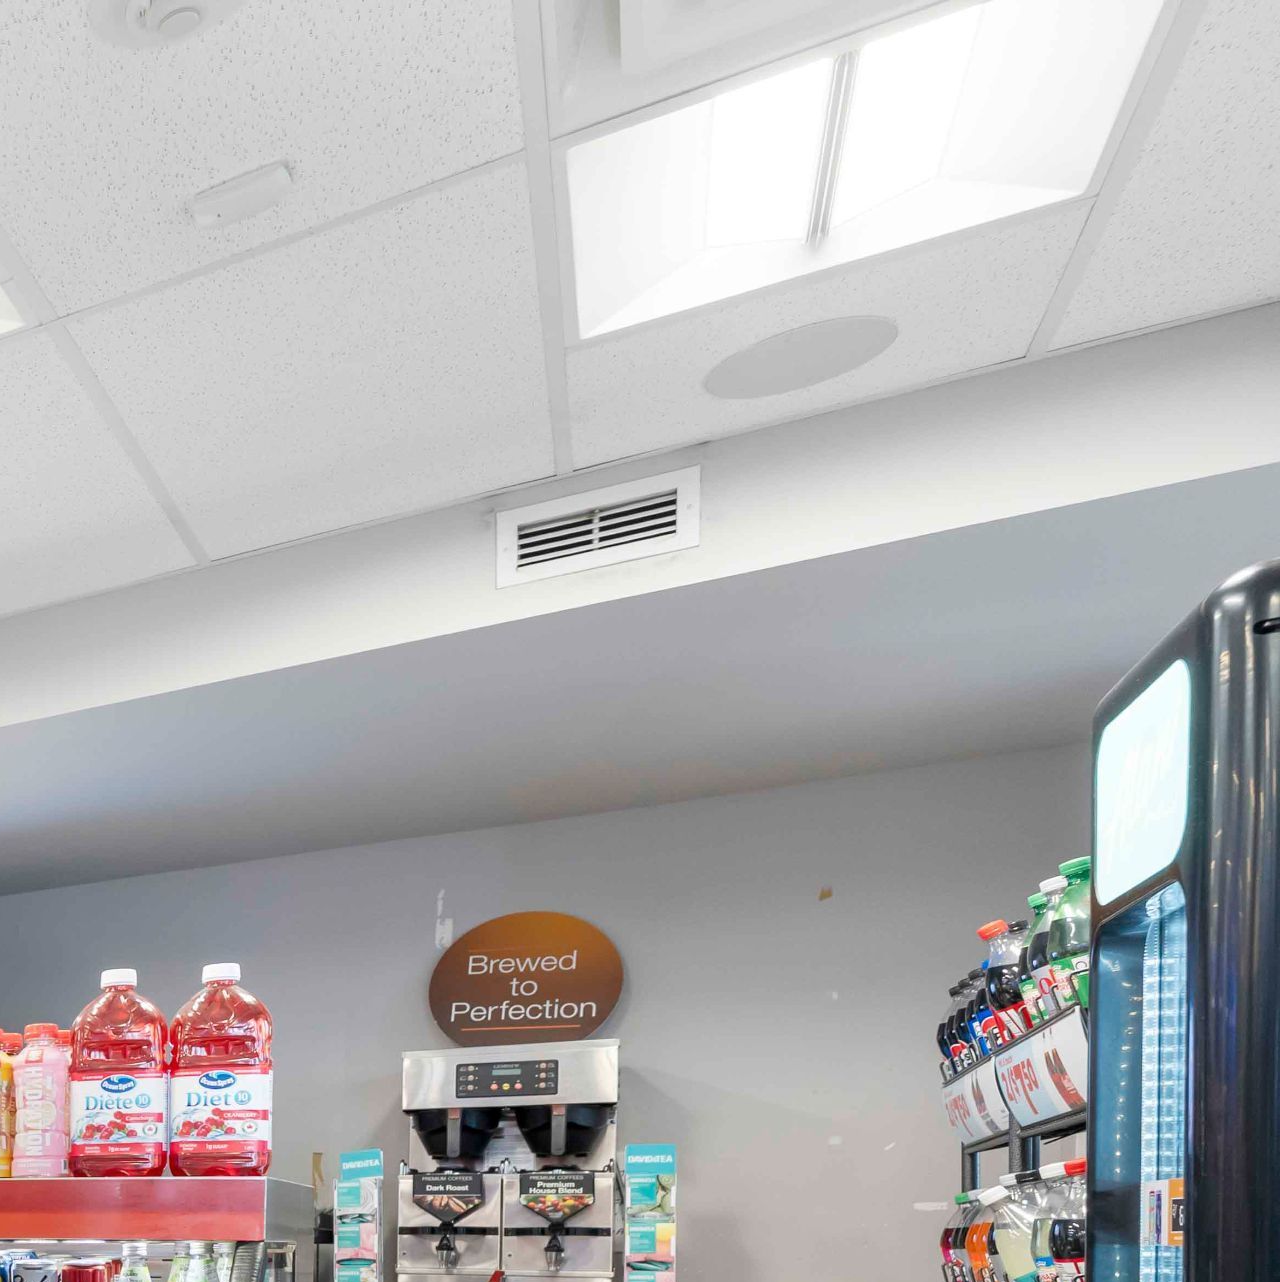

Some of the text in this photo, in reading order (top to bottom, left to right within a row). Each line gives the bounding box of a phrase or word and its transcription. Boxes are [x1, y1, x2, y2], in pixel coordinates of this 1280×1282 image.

[467, 950, 579, 976] Brewed
[509, 976, 539, 998] to
[449, 998, 598, 1024] Perfection
[84, 1094, 133, 1111] Diète
[186, 1090, 231, 1107] Diet
[557, 1186, 583, 1194] Blend
